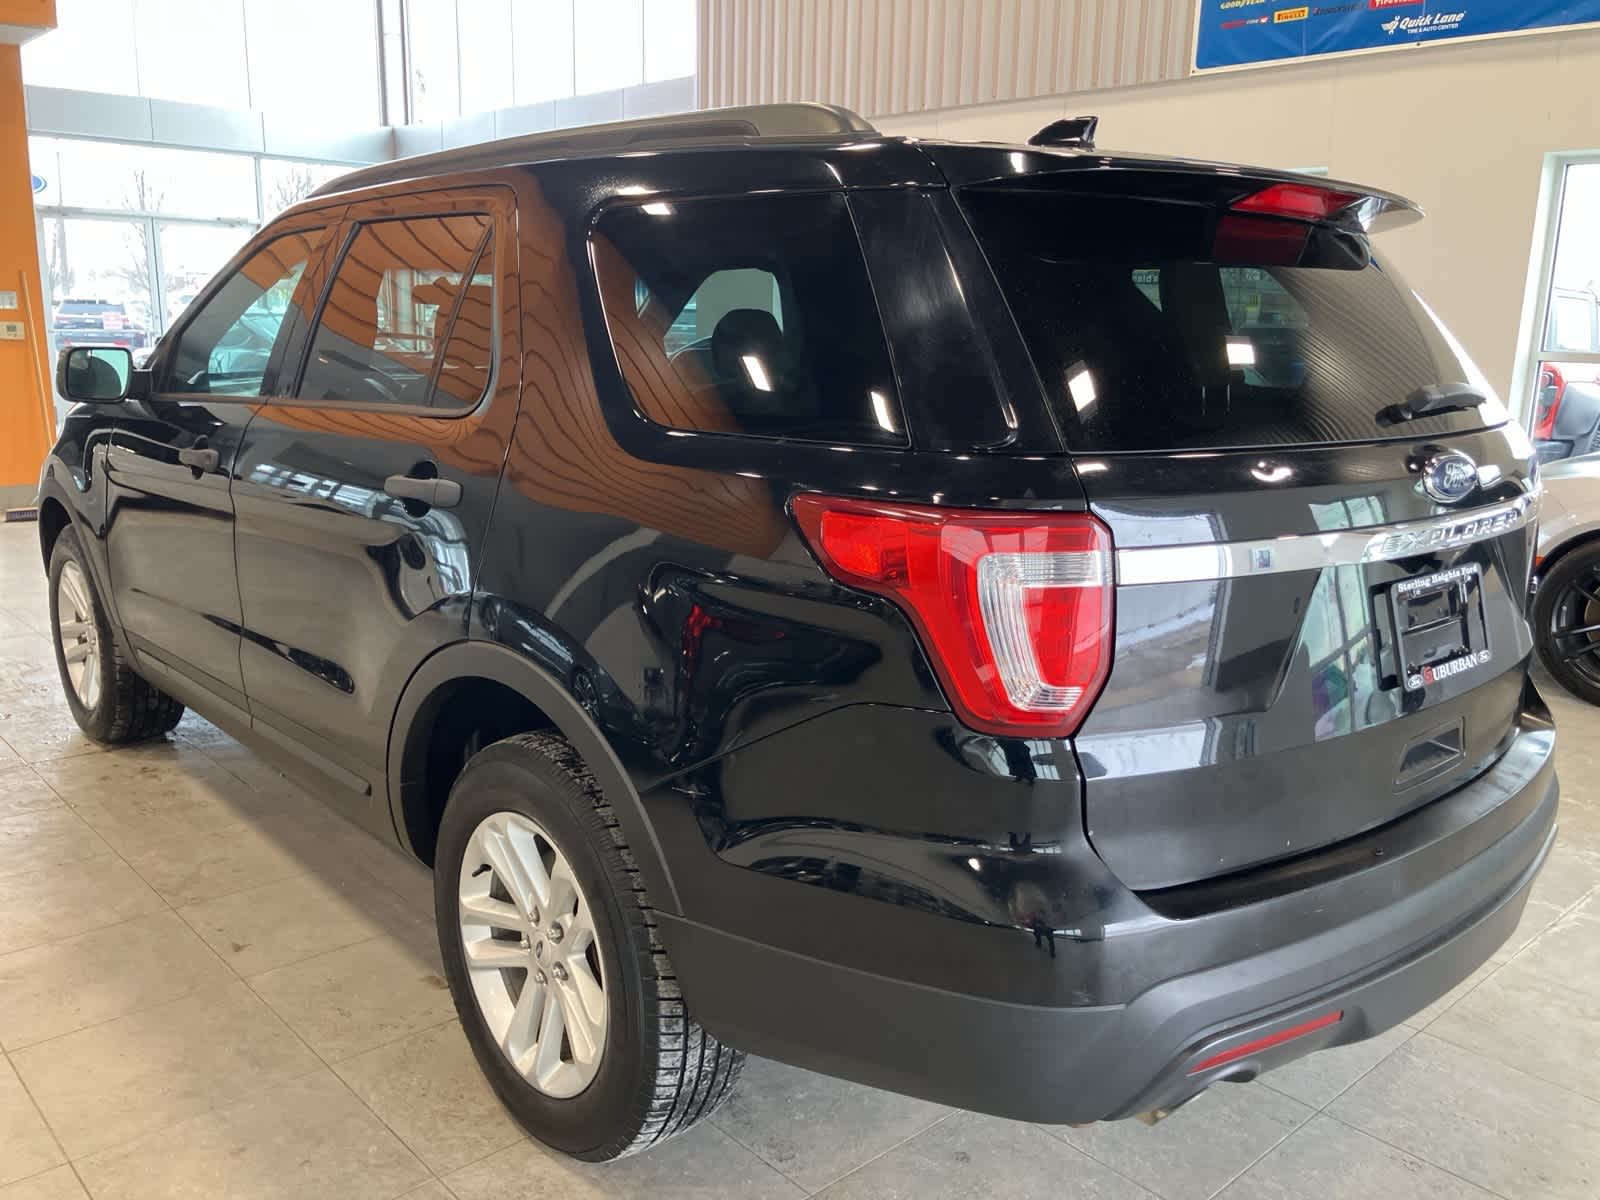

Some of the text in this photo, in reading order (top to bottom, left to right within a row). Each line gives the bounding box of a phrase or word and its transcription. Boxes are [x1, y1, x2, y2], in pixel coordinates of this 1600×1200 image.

[1400, 13, 1464, 29] Quick Lane
[1382, 511, 1518, 553] EXPLORER
[1398, 563, 1478, 593] Sterling Heights Ford
[1423, 652, 1478, 685] SUBURBAN
